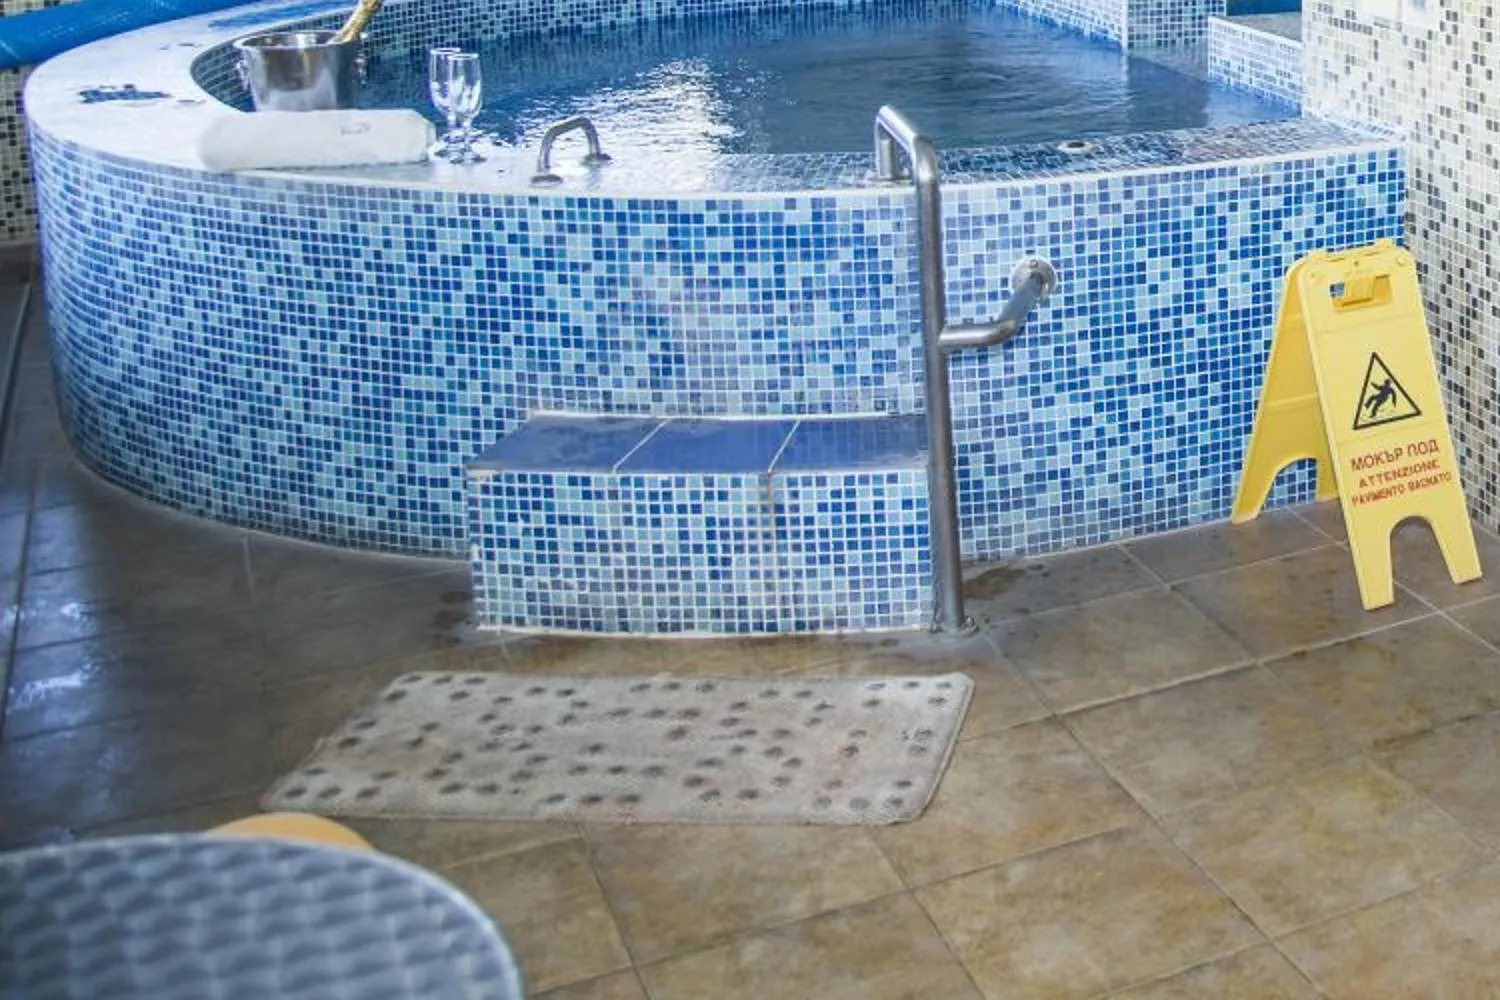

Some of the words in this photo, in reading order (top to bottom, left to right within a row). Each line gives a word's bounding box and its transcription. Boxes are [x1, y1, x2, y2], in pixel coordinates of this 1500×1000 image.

[1351, 447, 1403, 472] МОКЪР
[1407, 439, 1439, 457] ПОД
[1360, 459, 1440, 488] ATTENZIONE
[1351, 484, 1405, 506] PAVIMENTO
